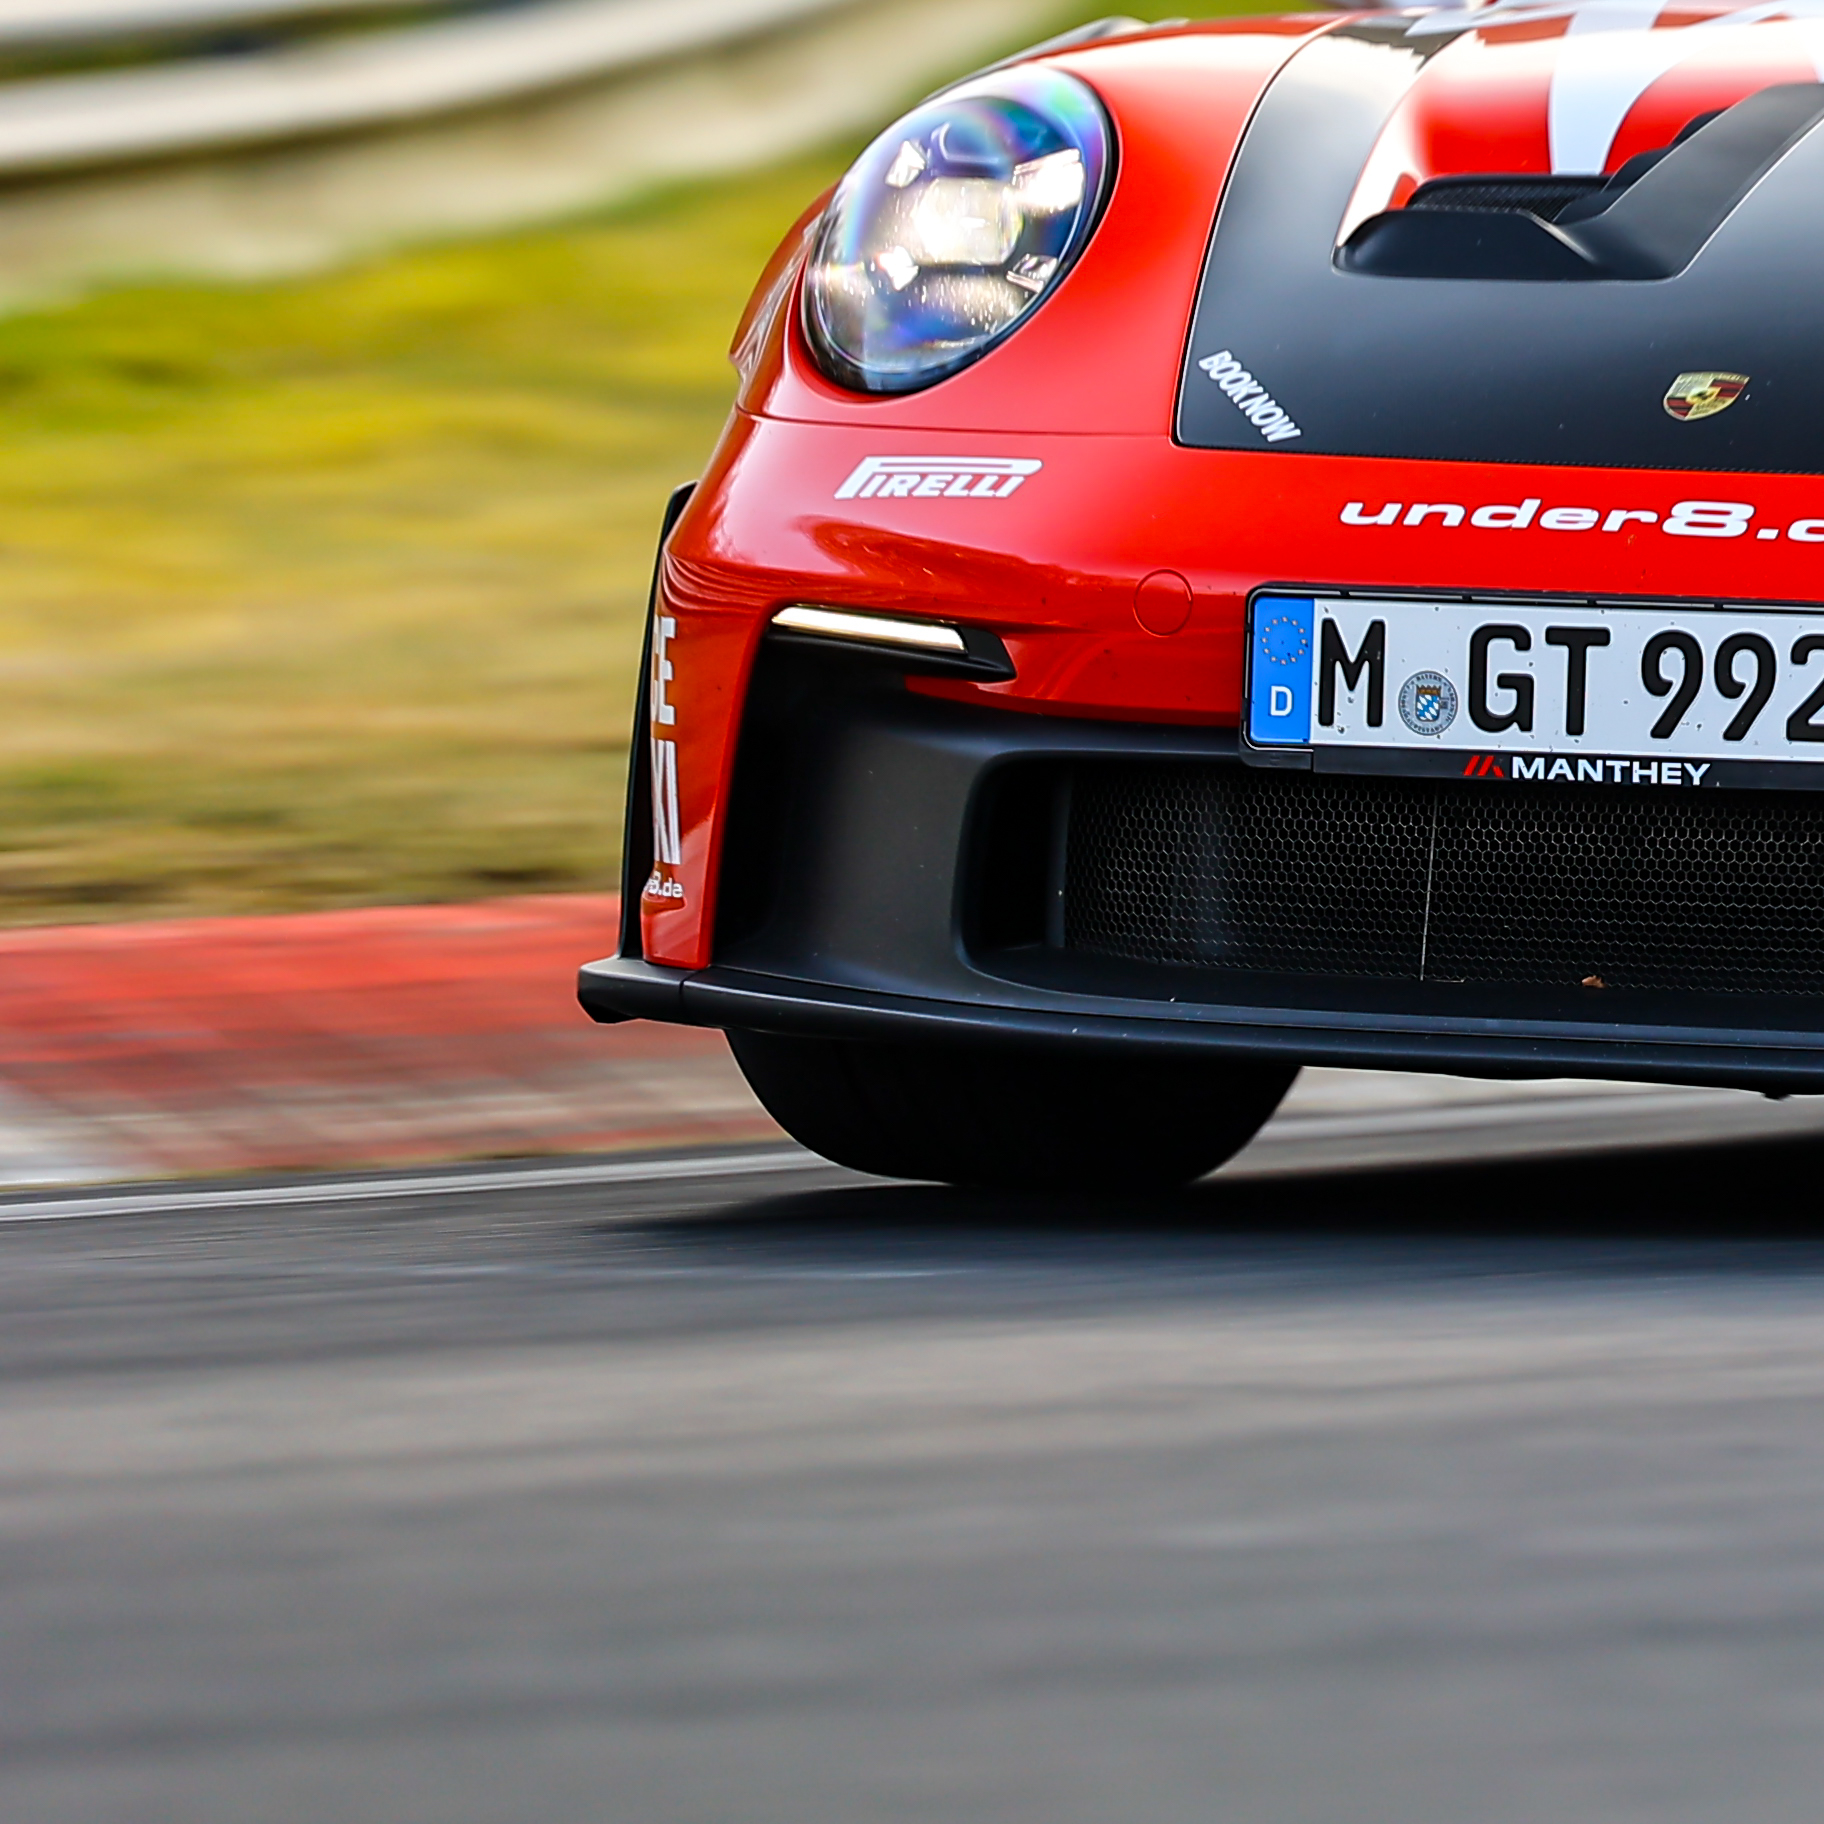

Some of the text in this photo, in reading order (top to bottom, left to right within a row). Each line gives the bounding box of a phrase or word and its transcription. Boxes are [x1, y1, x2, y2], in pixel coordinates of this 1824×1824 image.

[1198, 350, 1301, 443] BOOK NOW
[833, 455, 1043, 499] PIRELLI
[1318, 618, 1386, 727] M
[1468, 624, 1611, 736] GT
[1270, 686, 1292, 716] D
[1511, 757, 1711, 786] MANTHEY
